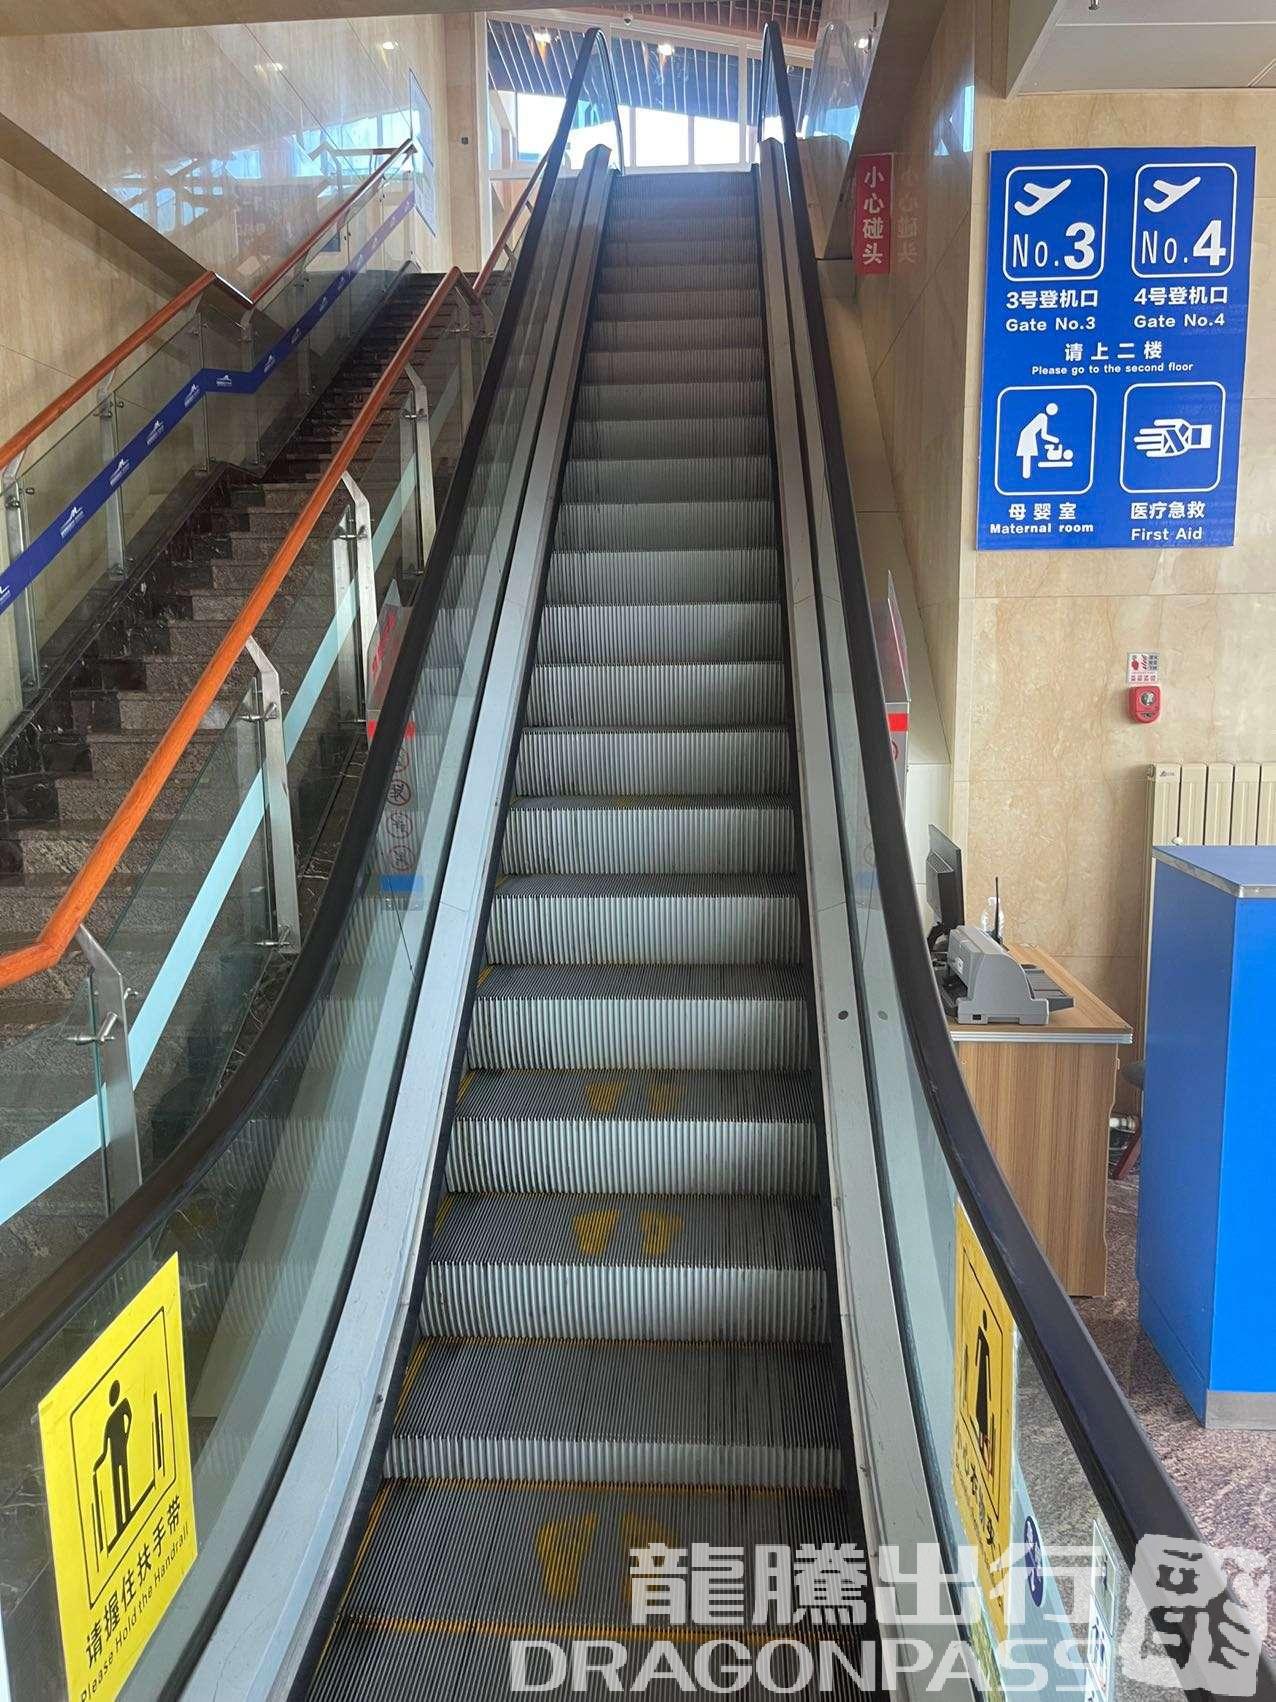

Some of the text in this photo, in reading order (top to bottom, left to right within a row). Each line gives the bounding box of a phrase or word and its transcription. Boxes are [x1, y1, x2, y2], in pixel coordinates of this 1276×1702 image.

[862, 165, 885, 266] 小心碰头
[1012, 221, 1096, 270] No.3
[1141, 219, 1227, 267] No.4
[1006, 289, 1099, 309] 3号登机口
[1133, 286, 1229, 306] 4号登机口
[1005, 316, 1096, 332] Gate No.3
[1133, 312, 1225, 328] Gate No.4
[1064, 340, 1163, 362] 请上二楼
[1031, 361, 1194, 376] Please go to the second floor
[1008, 502, 1077, 521] 母婴室
[1130, 501, 1206, 520] 医疗急救
[990, 523, 1094, 534] Maternal room
[1131, 526, 1203, 541] First Aid
[86, 1495, 181, 1669] 请握住扶手带
[80, 1651, 114, 1702] Please
[115, 1606, 137, 1653] Hold
[138, 1585, 153, 1614] the
